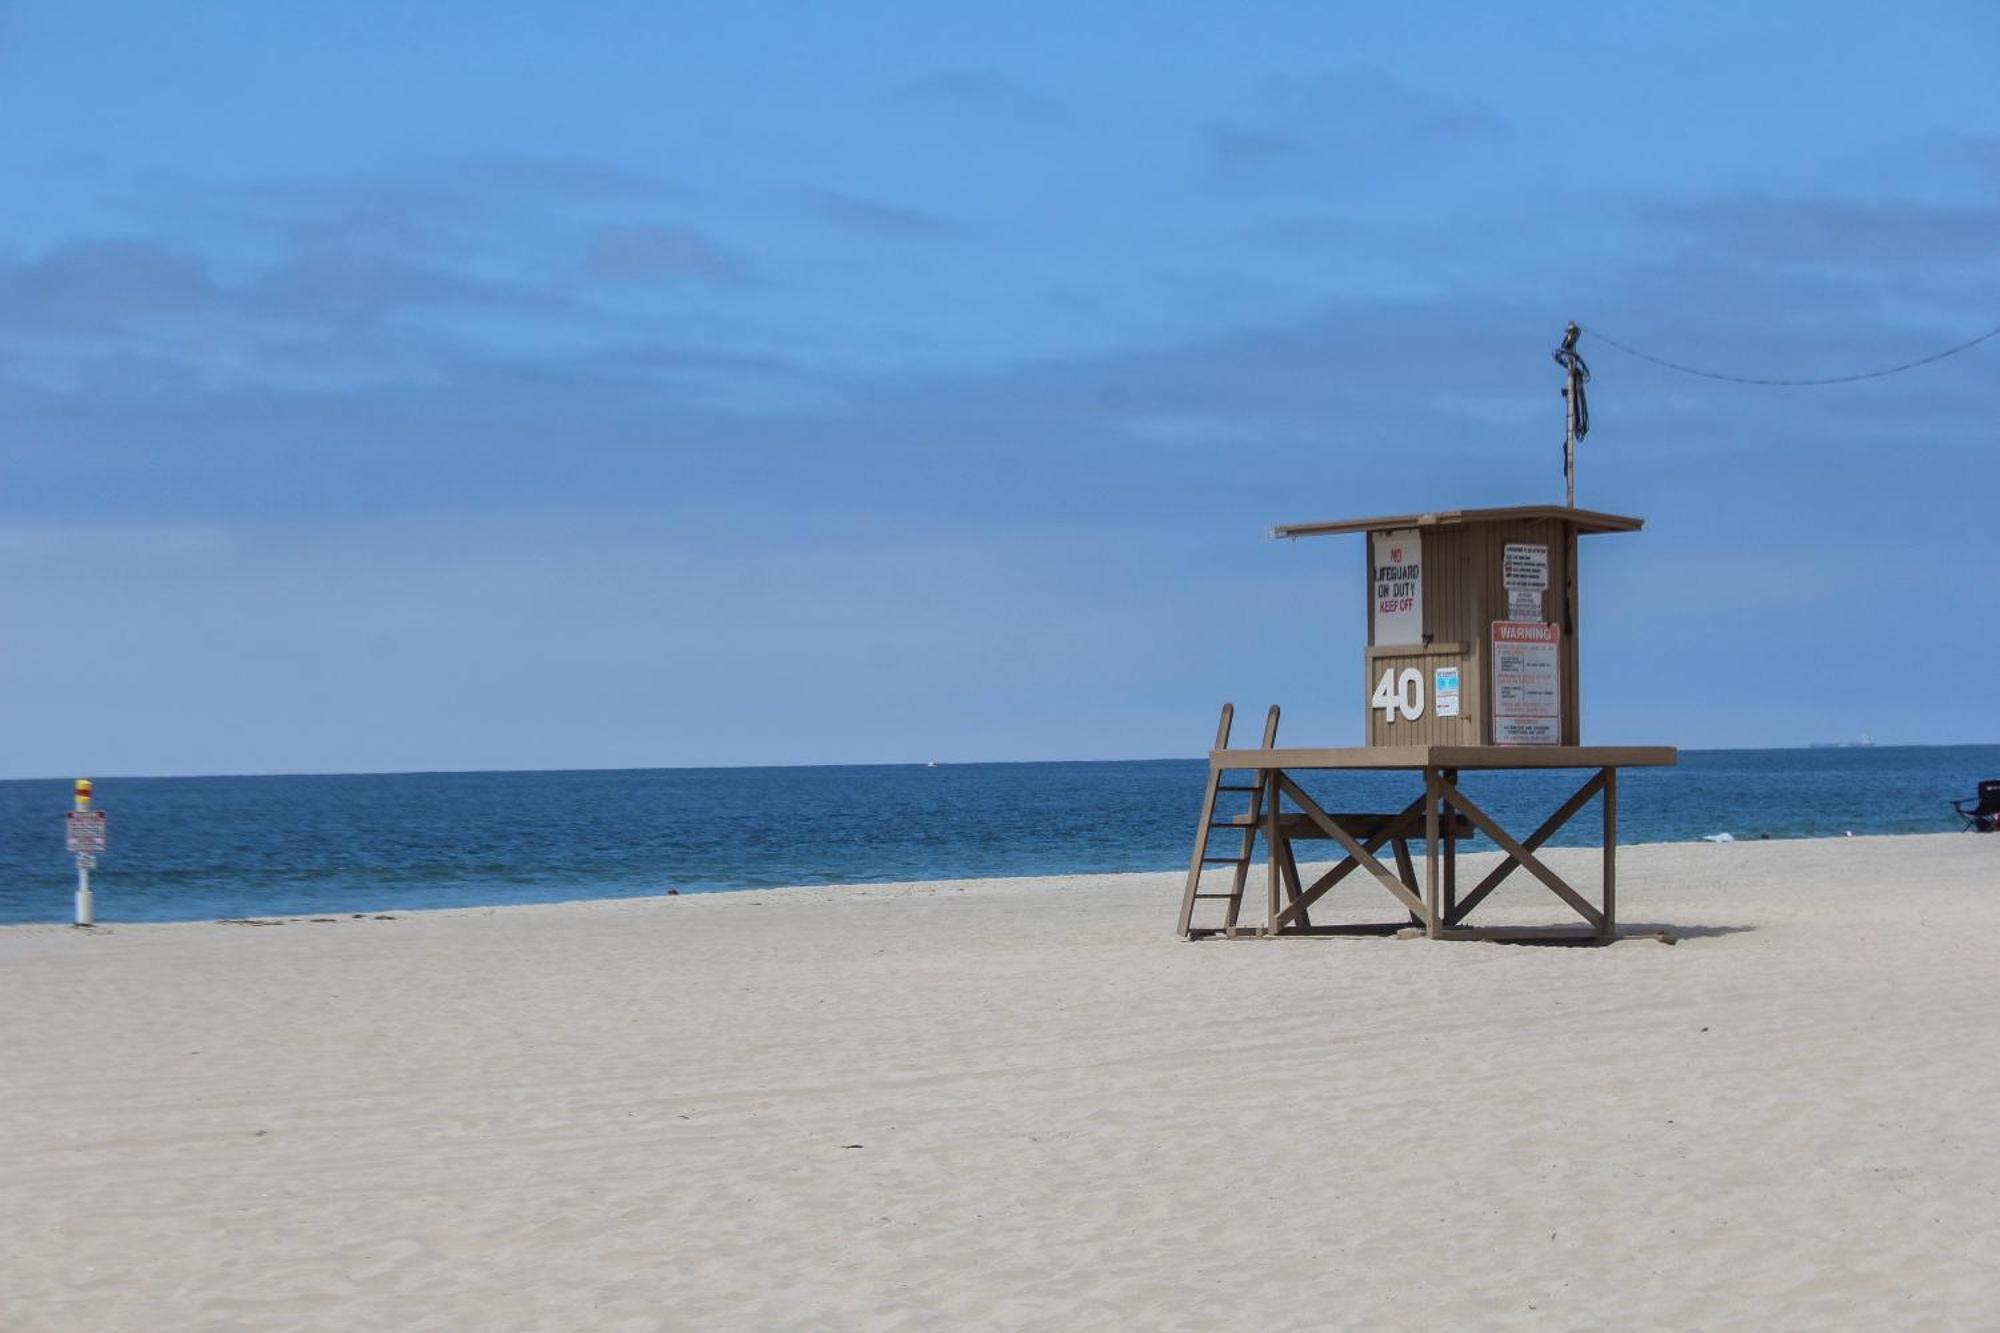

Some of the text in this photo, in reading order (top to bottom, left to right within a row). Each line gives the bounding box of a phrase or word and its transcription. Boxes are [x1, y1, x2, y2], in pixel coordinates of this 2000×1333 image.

[1389, 547, 1402, 562] NO
[1375, 565, 1420, 582] LIFEGUARD
[1377, 582, 1416, 599] ON DUTY
[1379, 598, 1414, 613] KEEP OFF
[1500, 625, 1552, 641] WARNING
[1372, 667, 1424, 723] 40
